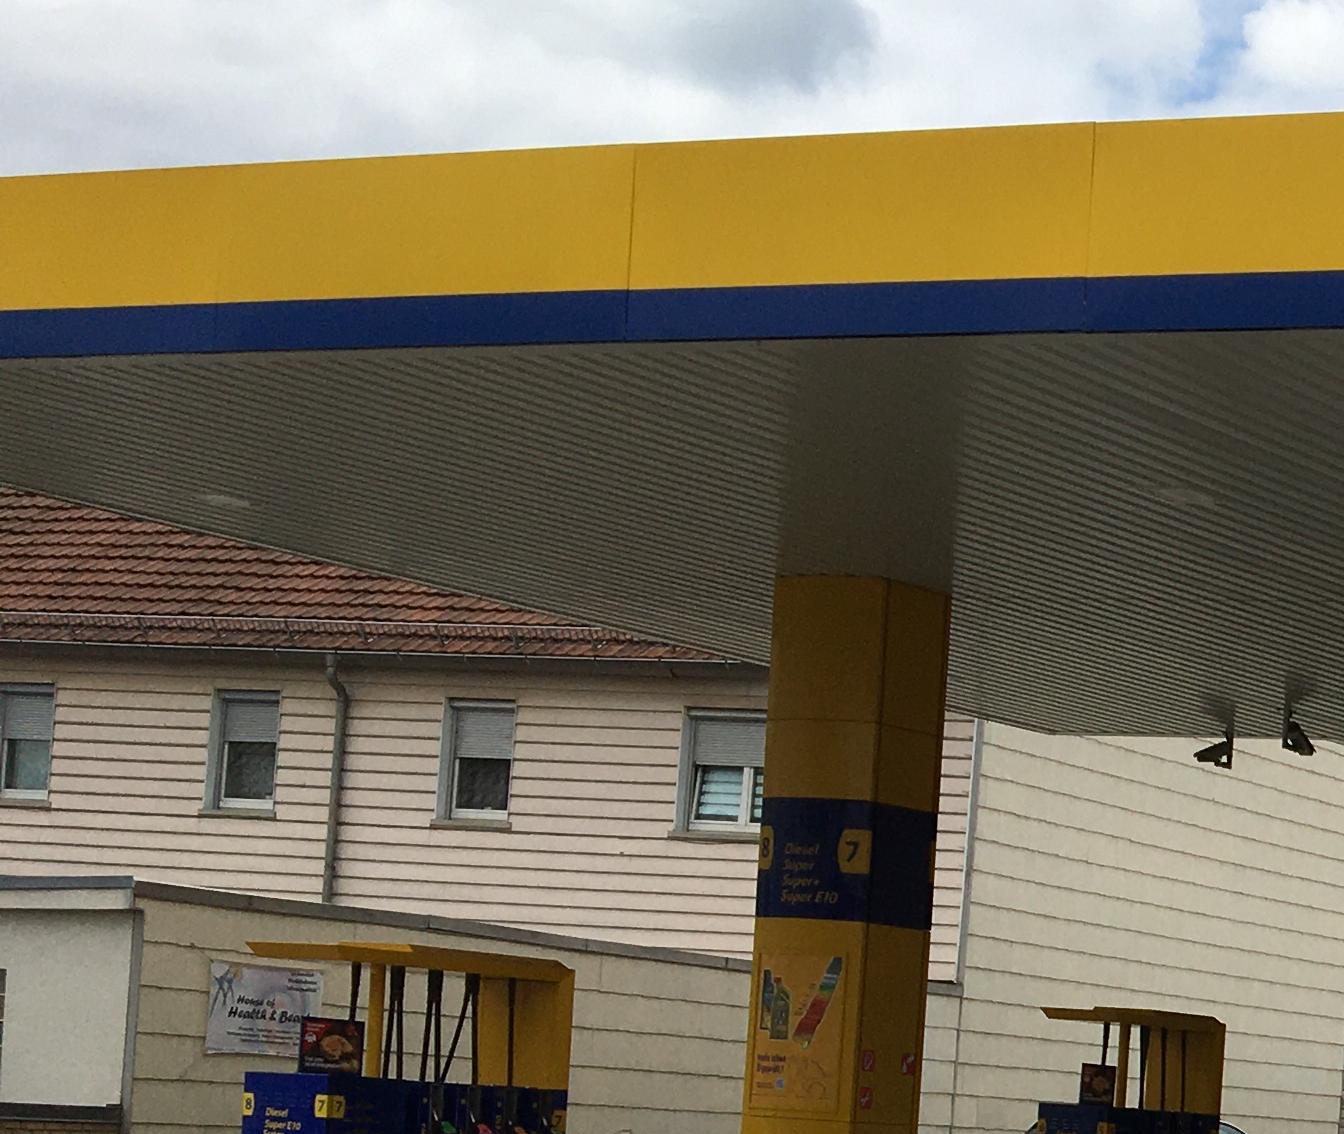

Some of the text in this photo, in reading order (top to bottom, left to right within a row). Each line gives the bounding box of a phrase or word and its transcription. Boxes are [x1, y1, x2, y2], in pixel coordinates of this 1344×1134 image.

[762, 836, 770, 858] 8
[845, 840, 859, 863] 7
[815, 891, 839, 905] E10
[227, 1006, 267, 1021] Health
[244, 1097, 253, 1110] 8
[318, 1099, 326, 1112] 7
[335, 1100, 343, 1113] 7
[264, 1107, 290, 1118] Diesel
[263, 1119, 286, 1130] Super
